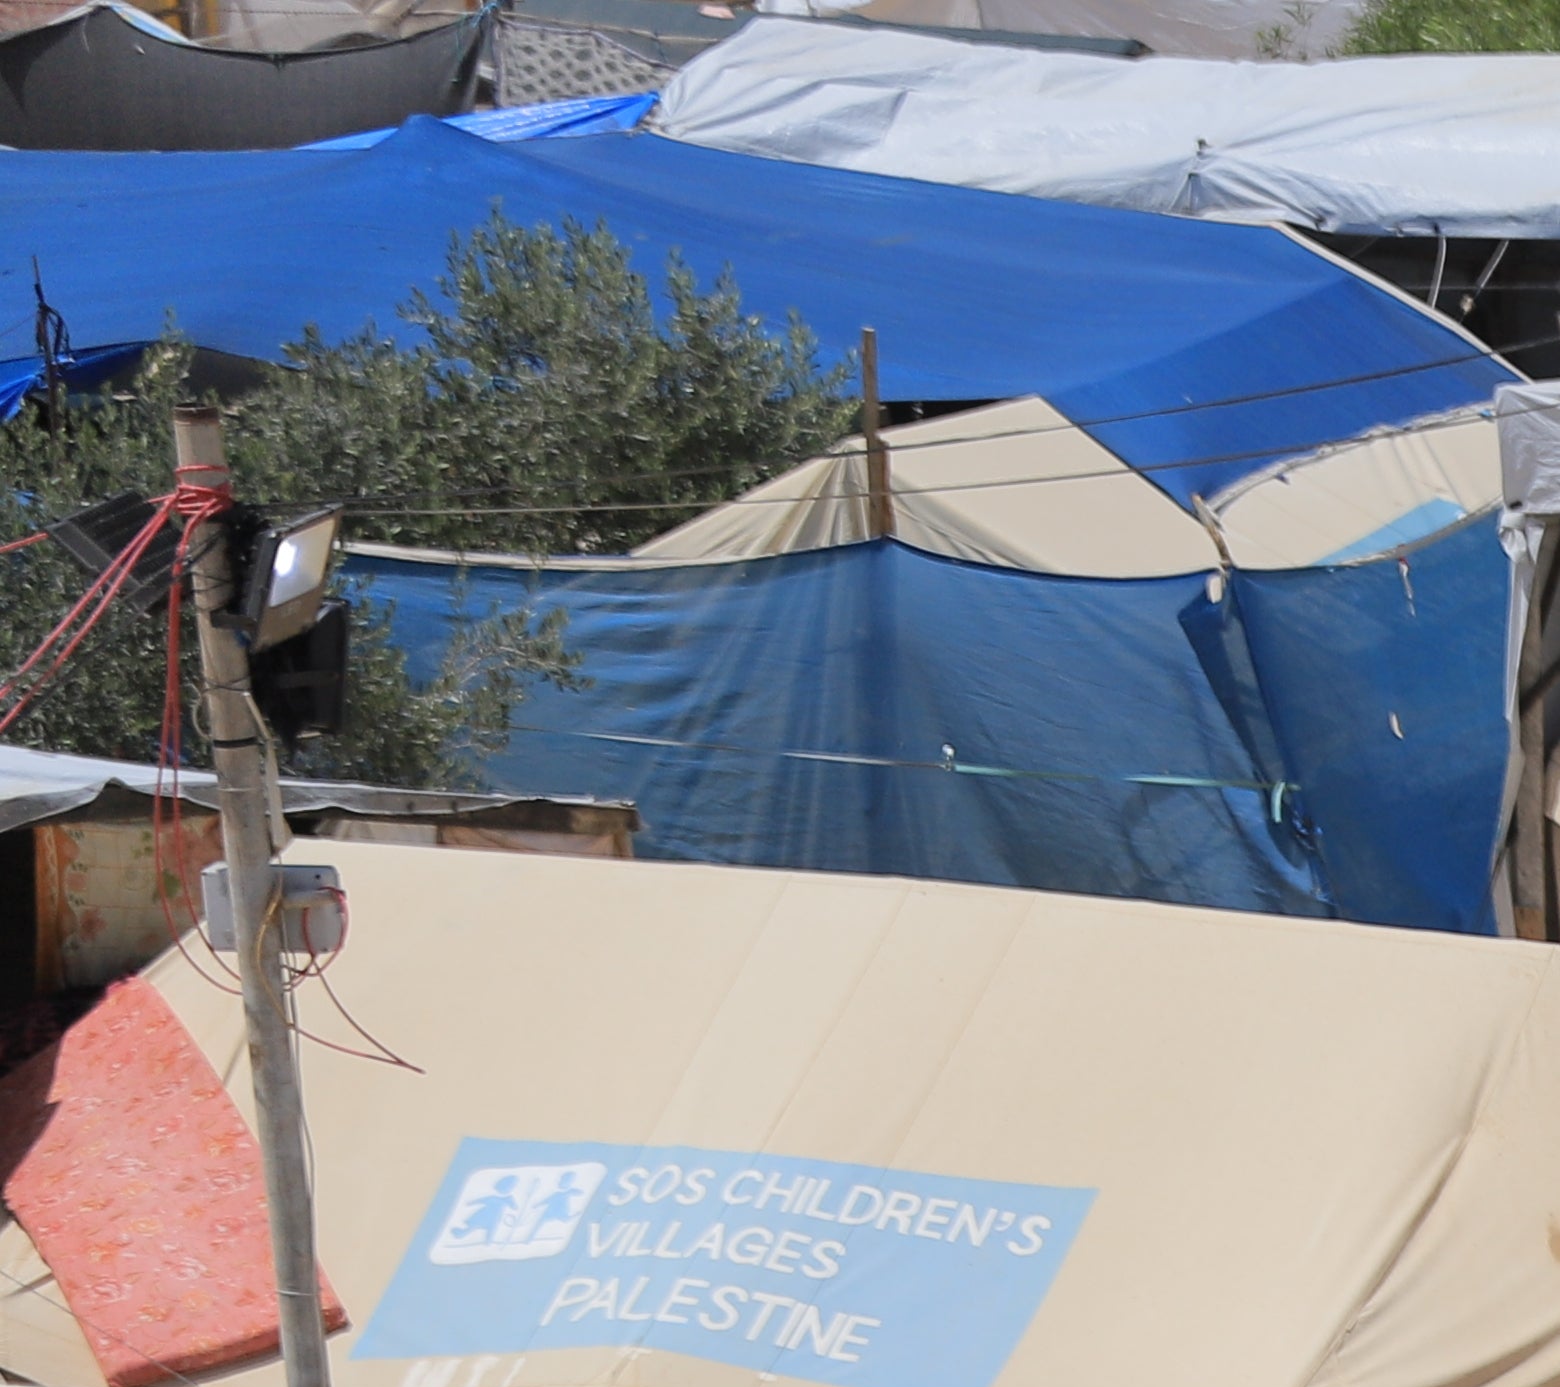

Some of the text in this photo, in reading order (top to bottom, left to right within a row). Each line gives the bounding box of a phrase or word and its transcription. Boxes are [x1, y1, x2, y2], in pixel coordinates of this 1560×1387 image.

[587, 1220, 846, 1280] VILLAGES
[608, 1163, 1051, 1257] SOS CHILDREN'S
[540, 1275, 881, 1363] PALESTINE
